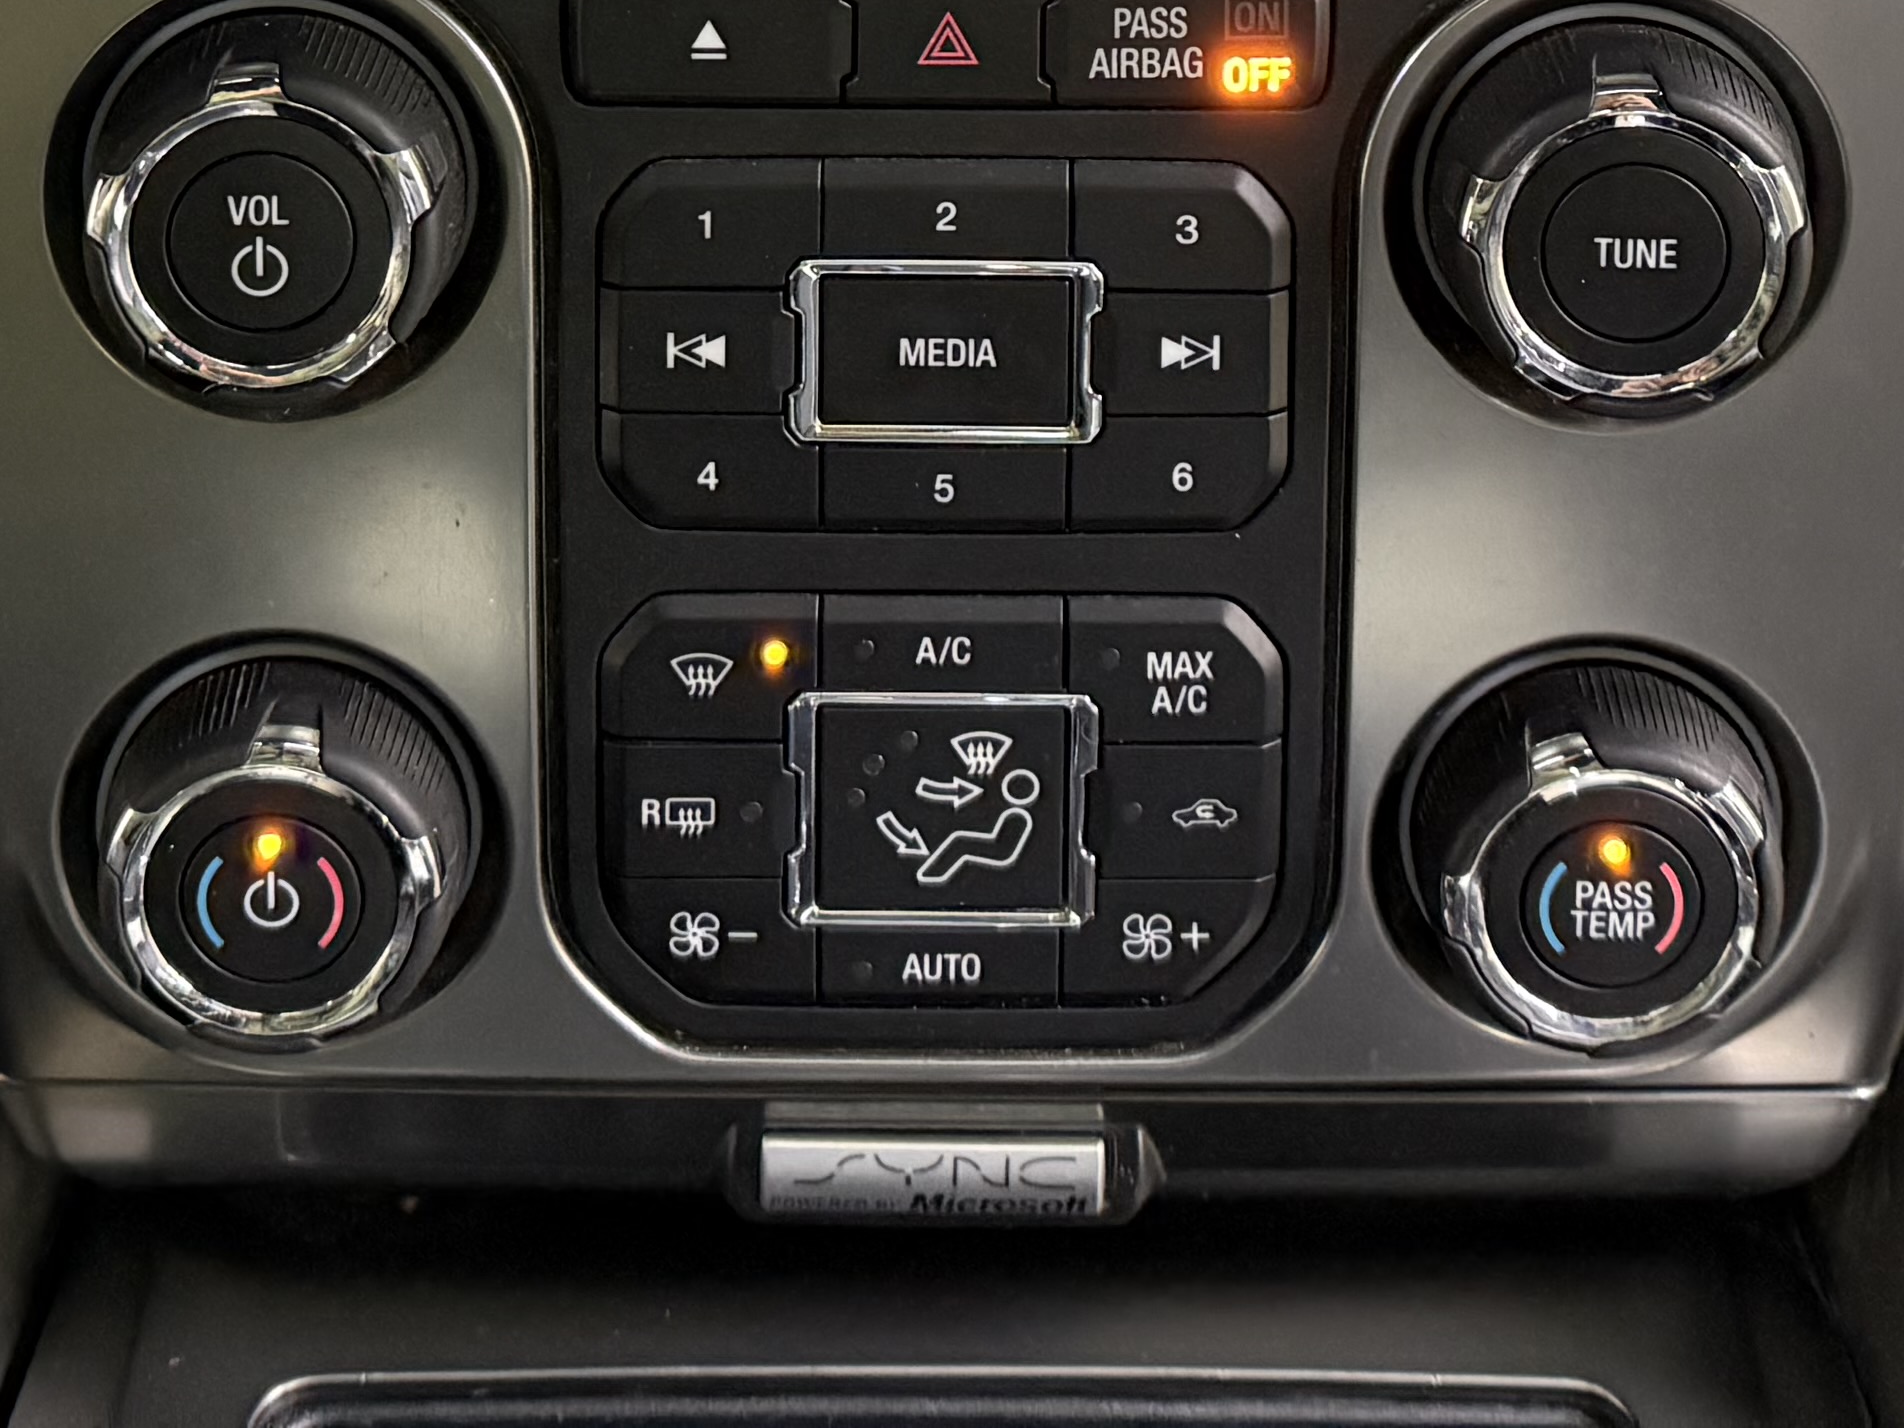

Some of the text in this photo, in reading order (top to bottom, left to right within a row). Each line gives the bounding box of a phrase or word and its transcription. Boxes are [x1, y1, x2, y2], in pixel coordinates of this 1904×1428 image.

[1113, 6, 1189, 41] PASS
[1088, 46, 1204, 80] AIRBAG
[1222, 55, 1293, 94] OFF
[227, 195, 290, 227] VOL
[698, 211, 713, 239] 1
[934, 202, 958, 233] 2
[1174, 214, 1199, 245] 3
[1593, 237, 1679, 270] TUNE
[898, 337, 997, 370] MEDIA
[696, 462, 719, 491] 4
[932, 474, 956, 504] 5
[1171, 462, 1194, 493] 6
[914, 637, 973, 667] A/C
[1145, 651, 1215, 681] MAX
[1151, 685, 1208, 715] A/C
[641, 799, 662, 827] R
[1574, 880, 1654, 910] PASS
[1570, 909, 1656, 941] TEMP
[902, 953, 982, 983] AUTO
[792, 1152, 1077, 1192] SYNC
[909, 1192, 1089, 1216] Microsoft
